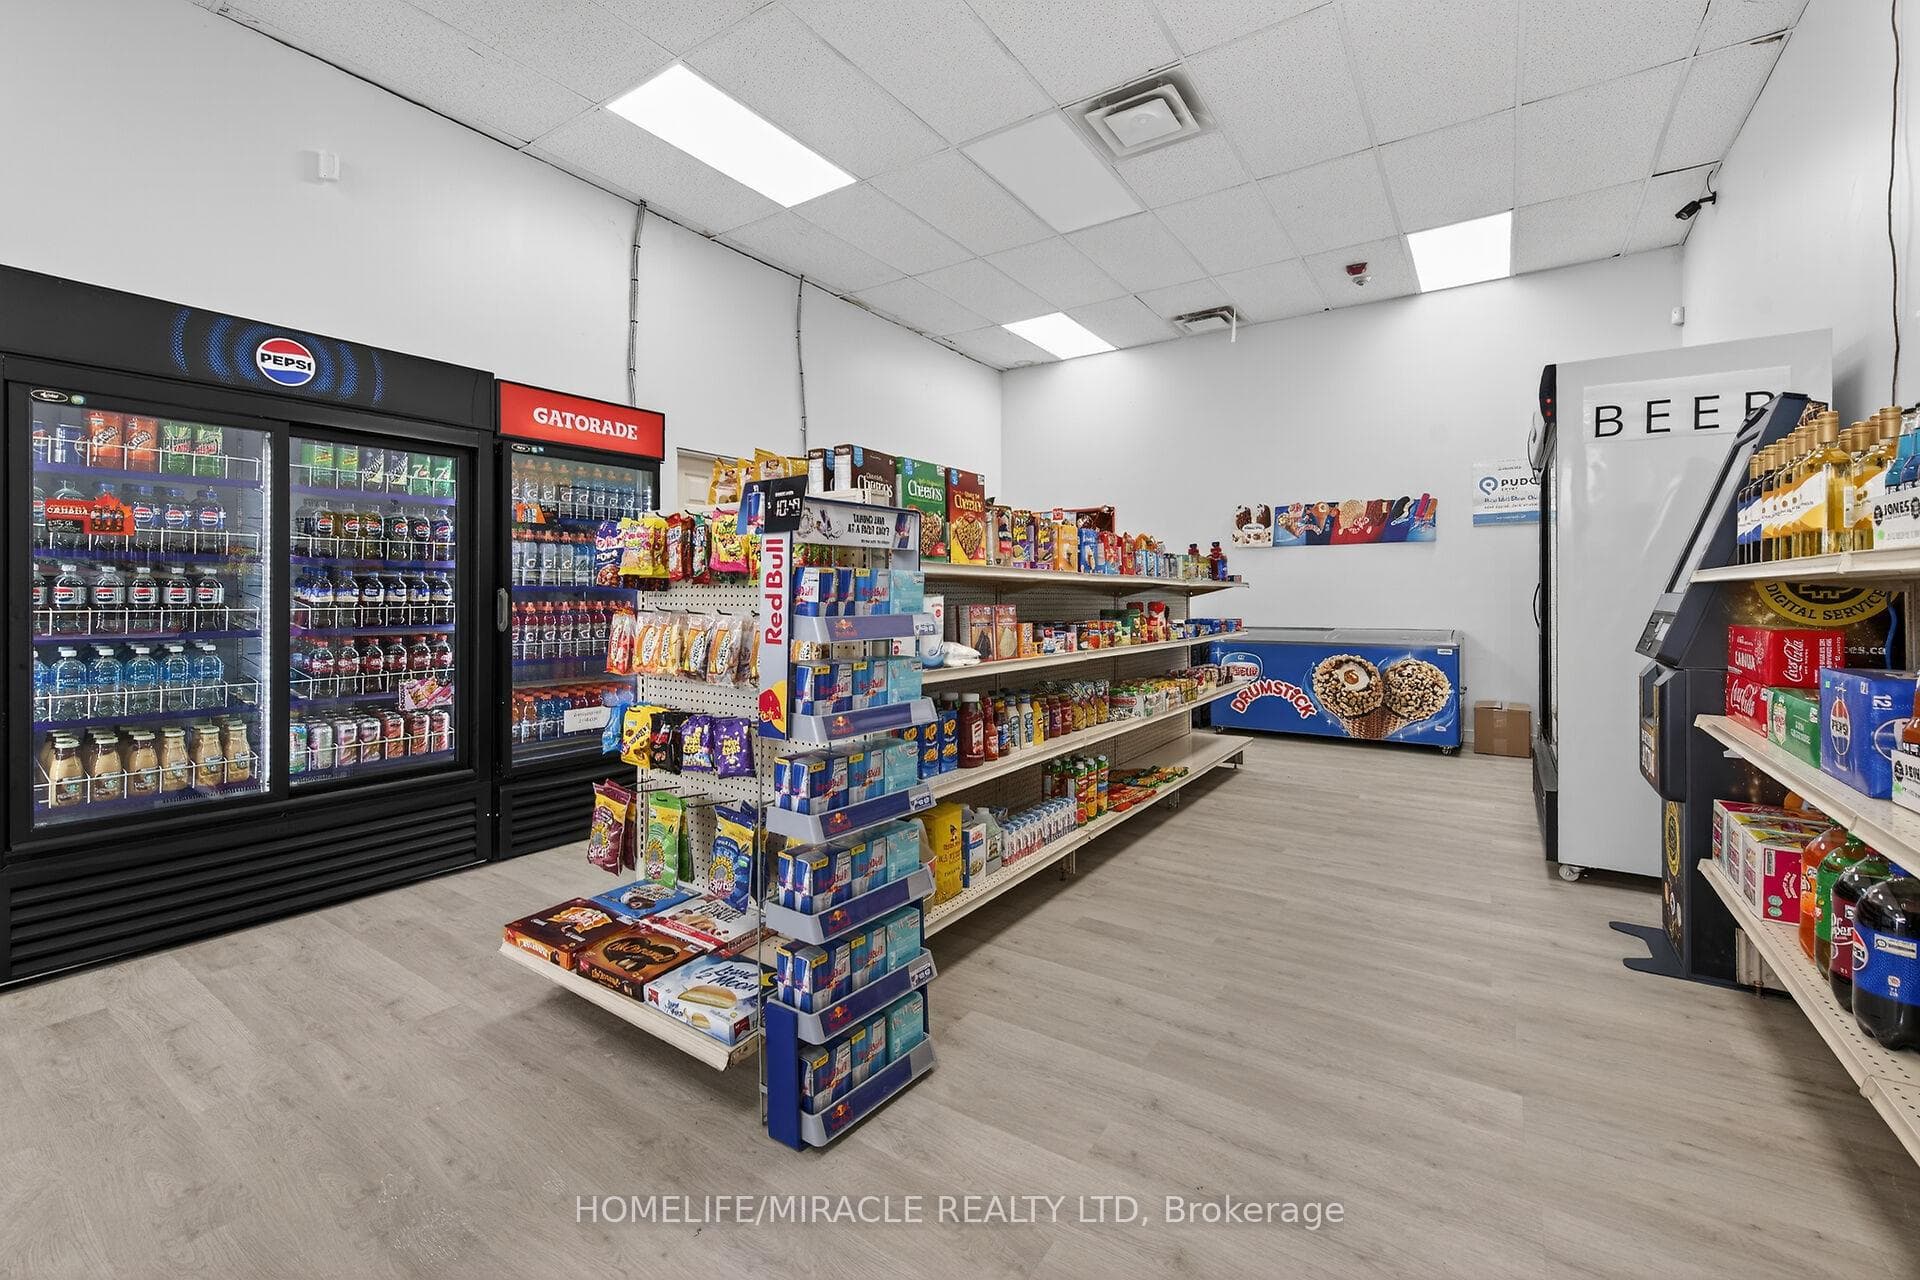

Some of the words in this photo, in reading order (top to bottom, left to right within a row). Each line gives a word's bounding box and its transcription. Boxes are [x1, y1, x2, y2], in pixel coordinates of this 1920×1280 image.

[260, 352, 313, 372] PEPSI
[533, 407, 638, 441] GATORADE
[908, 479, 943, 501] Cheerios
[1884, 501, 1910, 516] JONES
[765, 539, 784, 589] Bull
[1765, 583, 1817, 620] DIGITAL
[764, 594, 783, 646] Red
[1230, 679, 1318, 720] DRUMSTICK
